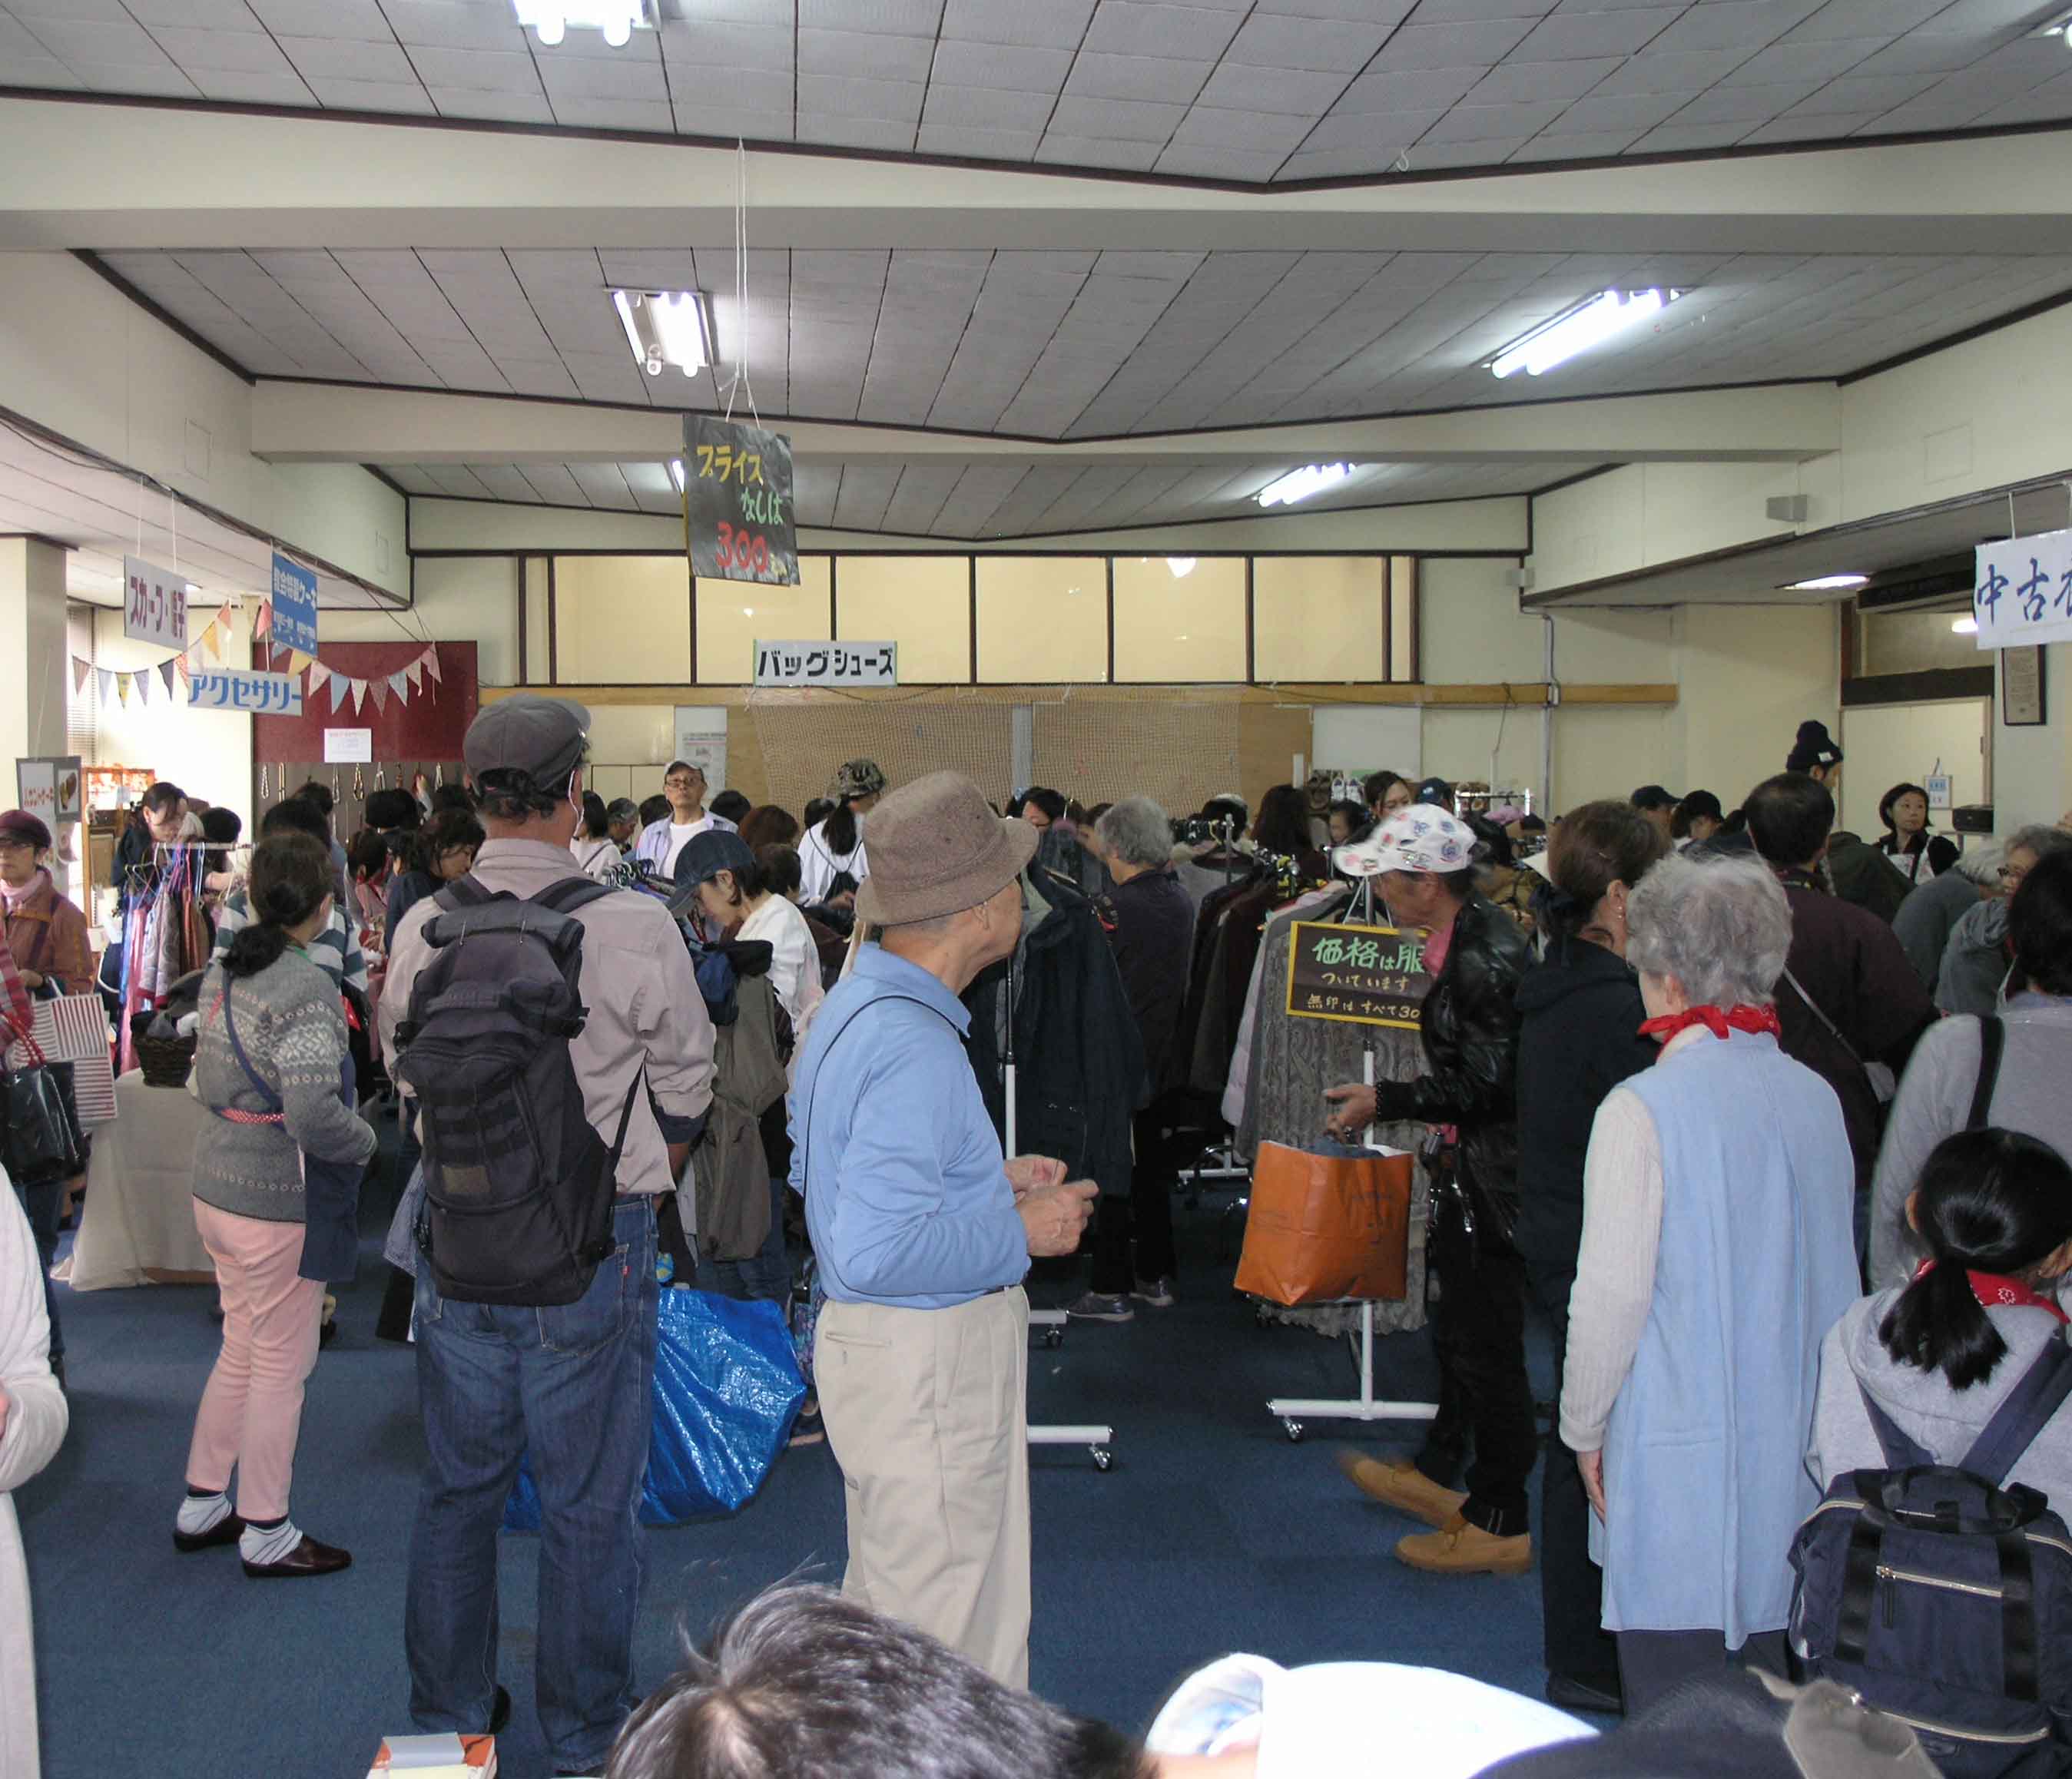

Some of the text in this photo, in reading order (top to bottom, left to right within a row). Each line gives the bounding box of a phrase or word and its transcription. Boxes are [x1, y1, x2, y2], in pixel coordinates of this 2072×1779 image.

[716, 521, 768, 573] 300
[758, 648, 893, 677] バッグシューズ
[188, 674, 302, 710] アクセサリー
